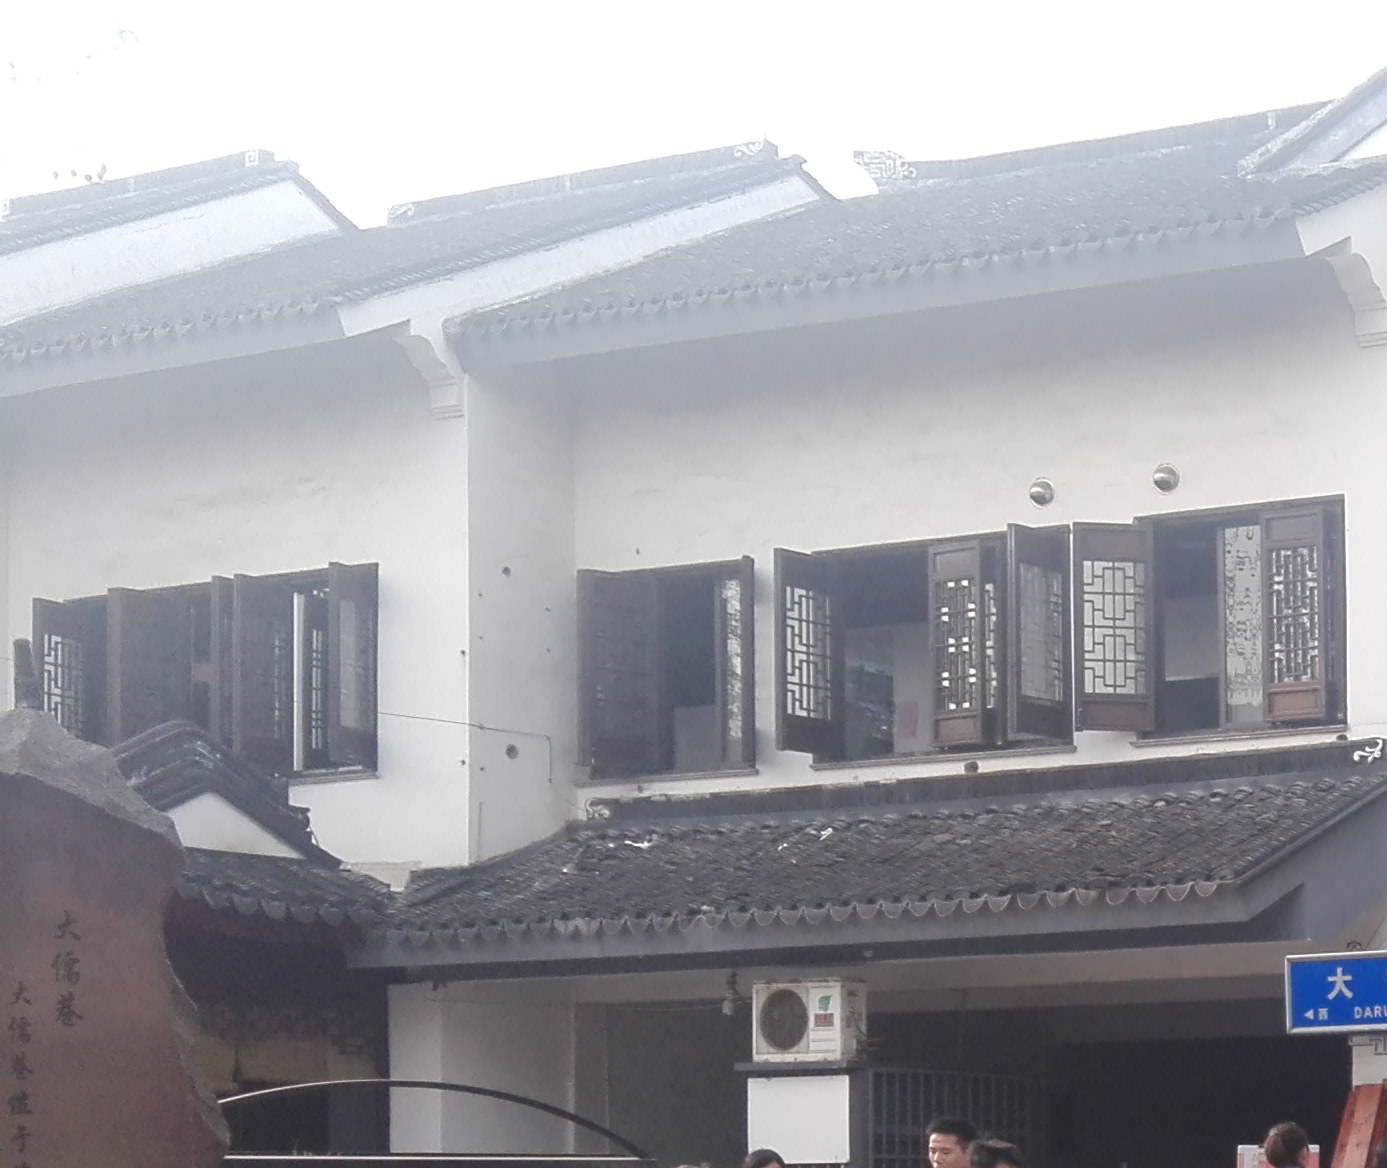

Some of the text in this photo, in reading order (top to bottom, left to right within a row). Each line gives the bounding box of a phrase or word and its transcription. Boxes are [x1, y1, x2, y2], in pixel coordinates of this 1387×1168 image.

[53, 909, 84, 1027] 大儒巷
[1318, 1008, 1329, 1020] 西
